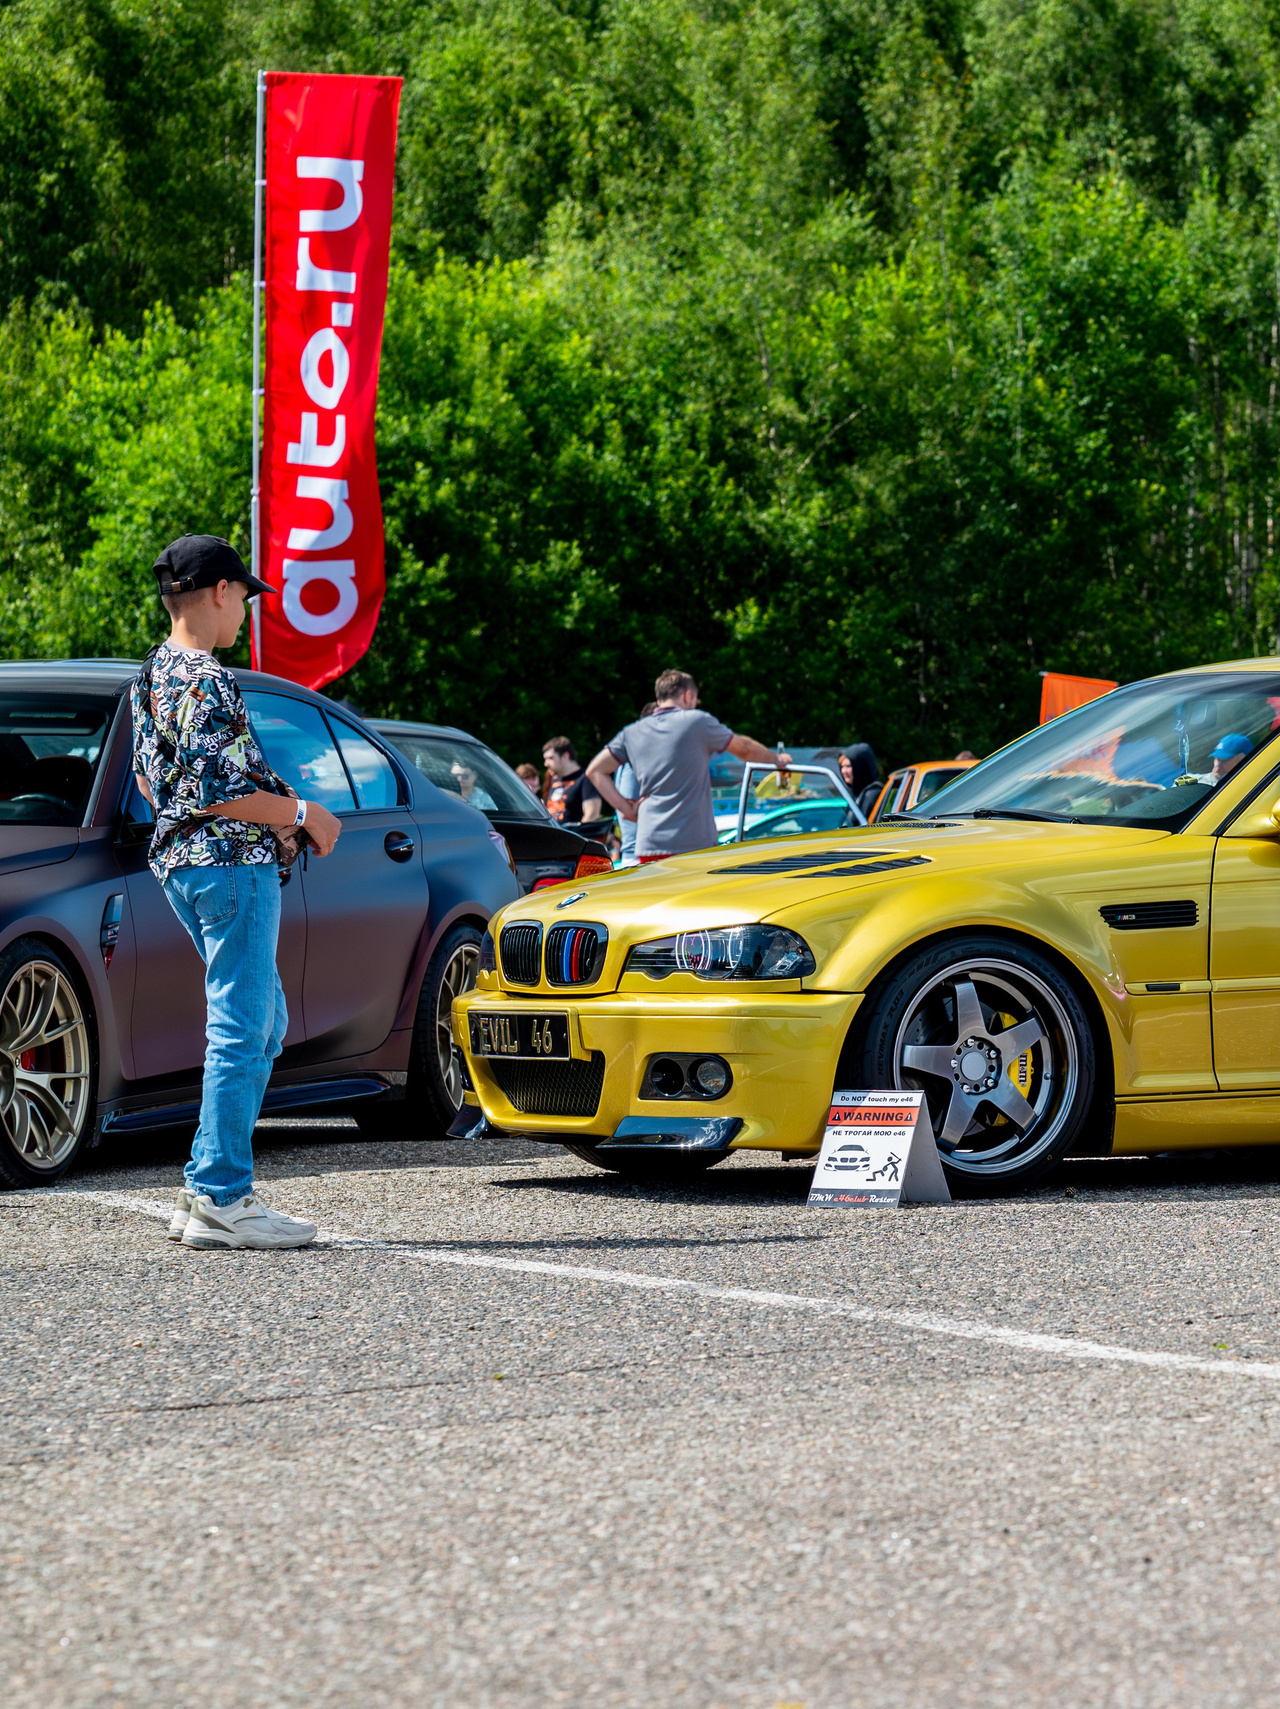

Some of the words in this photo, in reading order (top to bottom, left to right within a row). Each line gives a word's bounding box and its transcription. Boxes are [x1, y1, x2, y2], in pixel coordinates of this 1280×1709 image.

[282, 156, 364, 636] auto.ru
[480, 1018, 518, 1053] EVIL
[531, 1019, 553, 1054] 46
[843, 1112, 904, 1121] WARNING
[810, 1194, 834, 1202] BMW
[869, 1194, 897, 1203] Rostov
